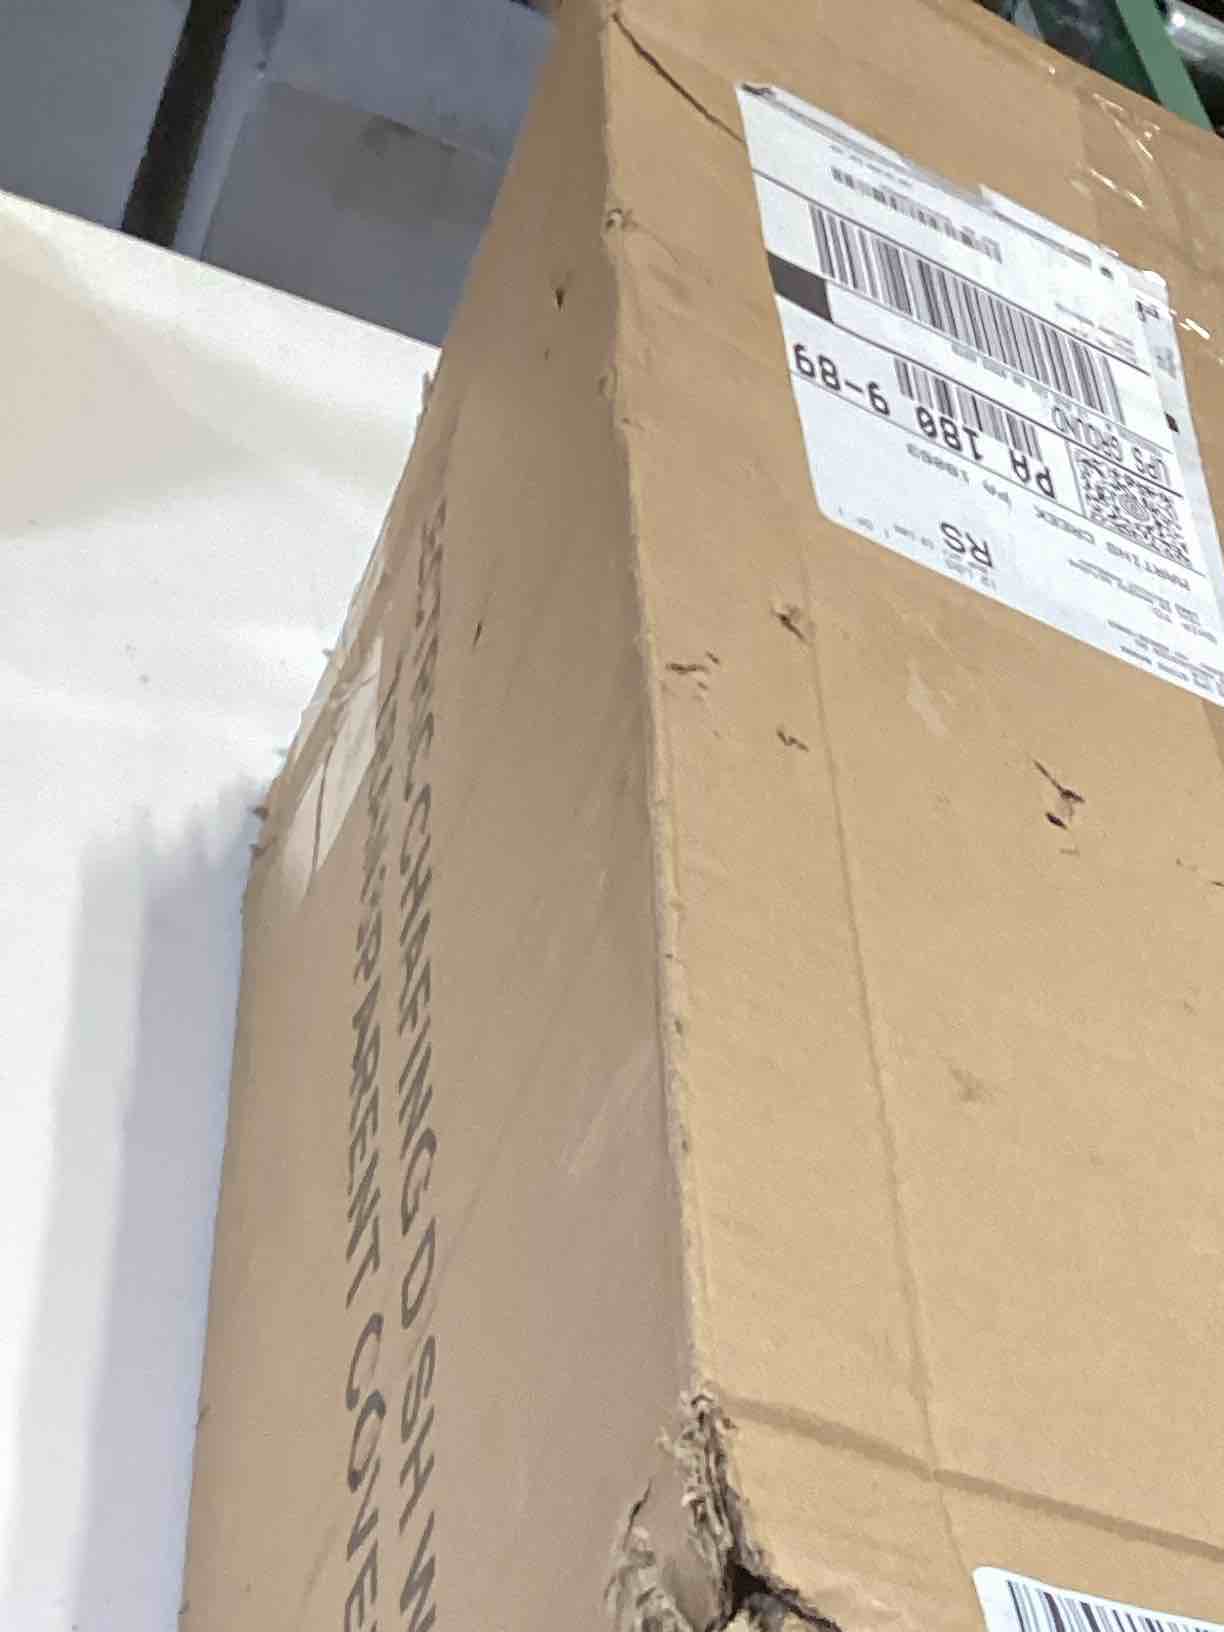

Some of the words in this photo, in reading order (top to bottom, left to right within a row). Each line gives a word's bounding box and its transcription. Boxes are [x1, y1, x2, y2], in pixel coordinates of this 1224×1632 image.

[791, 341, 890, 417] 9-89
[913, 402, 984, 463] 180
[1007, 447, 1055, 499] PA
[937, 518, 993, 569] RS
[398, 782, 438, 1238] CHAFING
[399, 1211, 438, 1537] DSH
